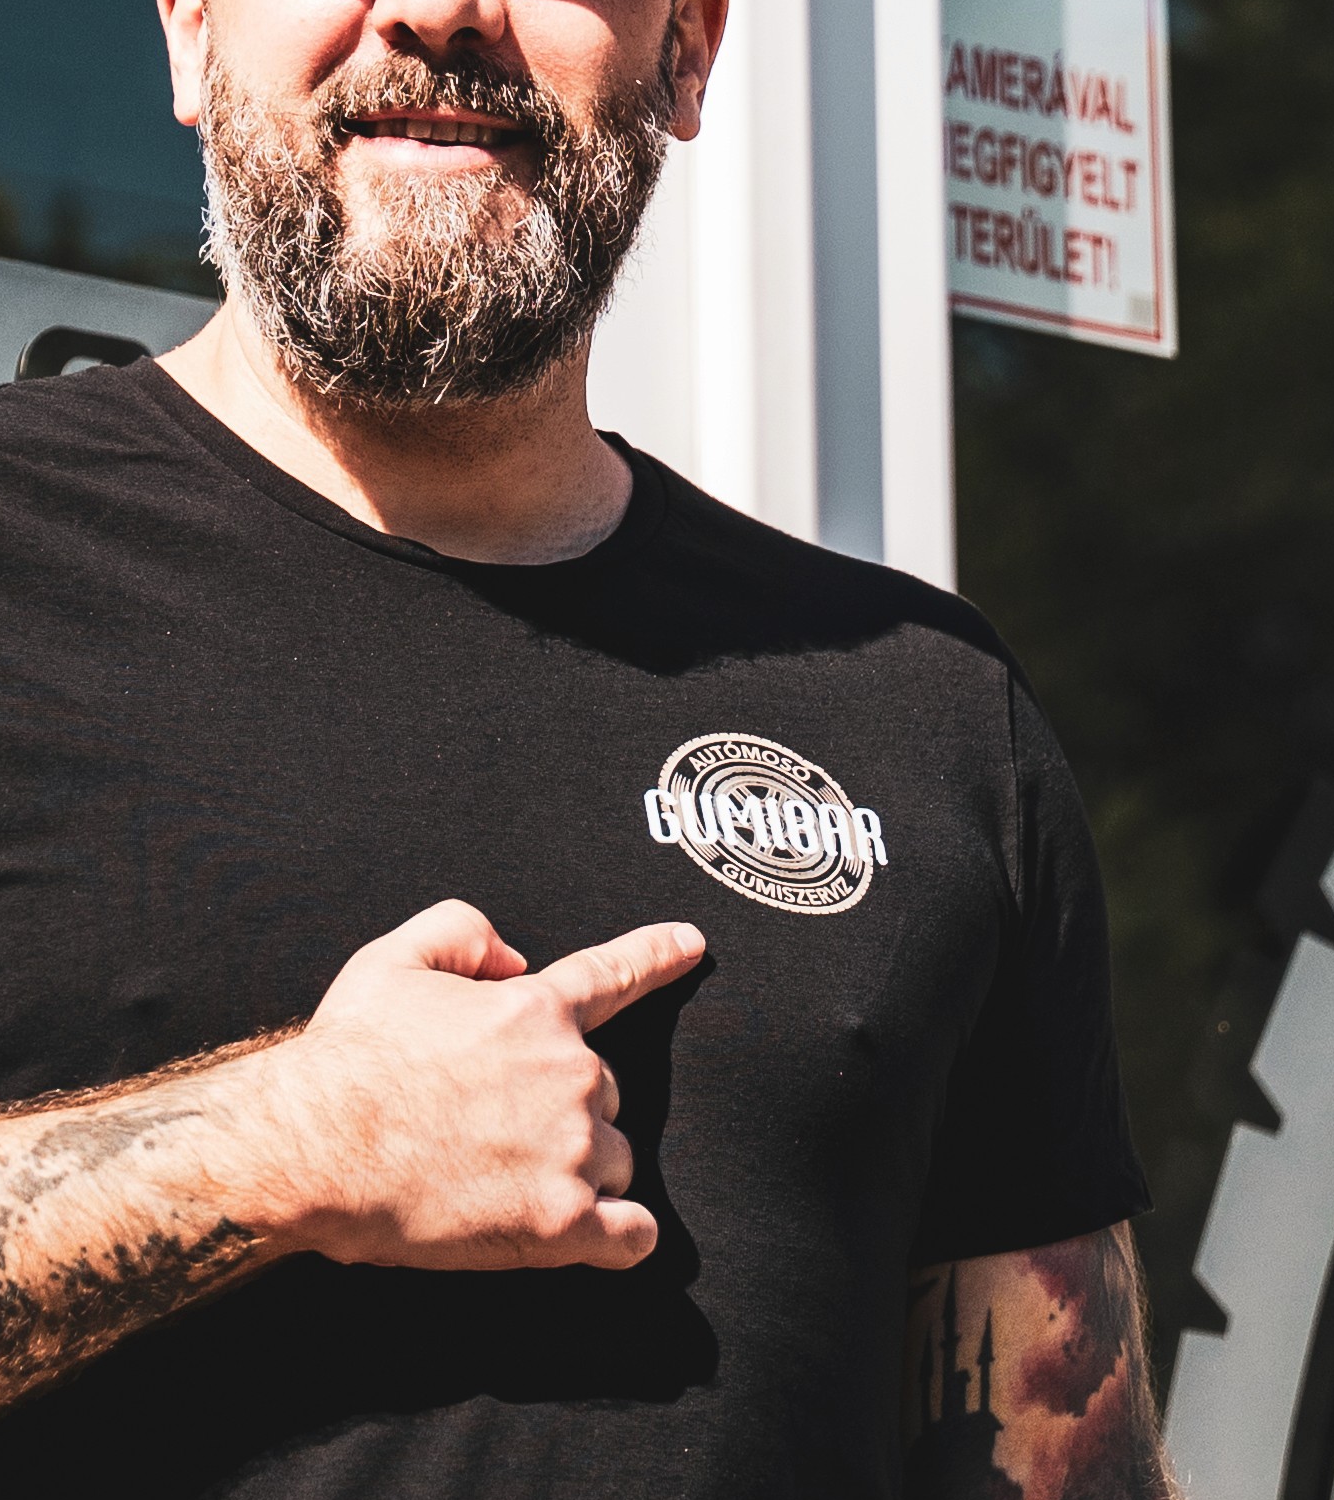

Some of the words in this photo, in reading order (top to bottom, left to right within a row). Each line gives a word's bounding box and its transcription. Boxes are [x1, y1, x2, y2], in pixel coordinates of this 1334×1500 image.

[943, 38, 1137, 135] AMERÁVAL
[942, 118, 1139, 212] EGFIGYELT
[644, 789, 888, 866] GUMIBAR
[721, 863, 854, 906] GUMISZERVIZ
